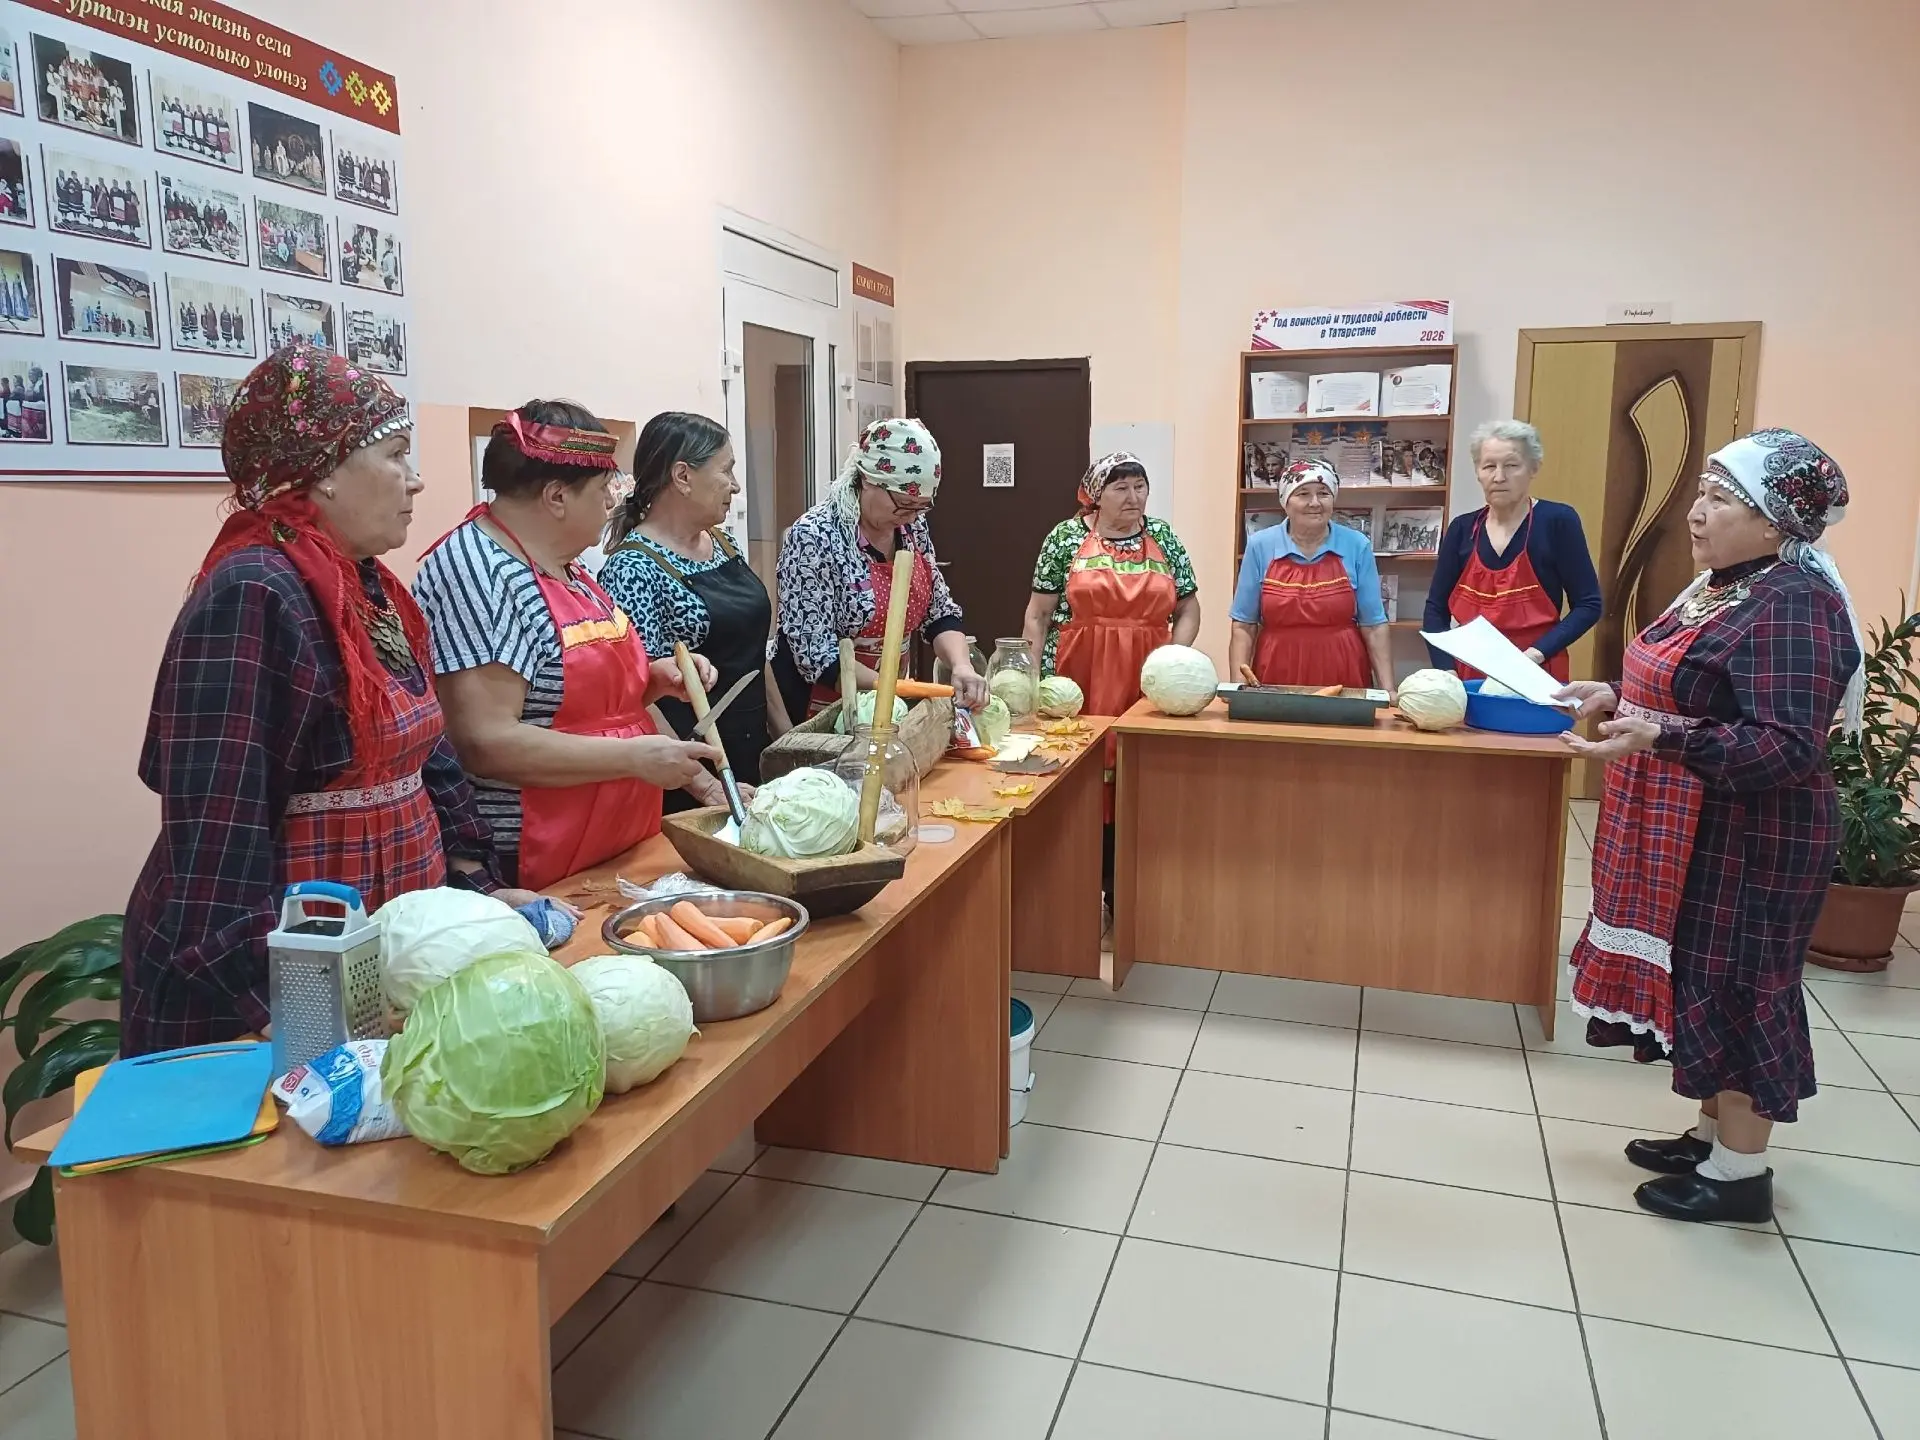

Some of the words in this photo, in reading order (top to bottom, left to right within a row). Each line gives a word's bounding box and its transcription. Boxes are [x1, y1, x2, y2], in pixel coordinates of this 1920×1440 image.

[142, 0, 184, 15] кая
[189, 6, 251, 41] жизнь
[255, 32, 292, 58] села
[49, 0, 149, 33] уртлэн
[153, 23, 251, 69] устолыко
[253, 59, 308, 91] улонэз
[1273, 317, 1288, 328] Год
[1290, 313, 1332, 327] воинской
[1333, 314, 1340, 324] и
[1341, 310, 1383, 325] трудовой
[1384, 309, 1428, 323] доблести
[1320, 329, 1326, 338] в
[1328, 326, 1377, 339] Татарстане
[1419, 330, 1445, 342] 2026
